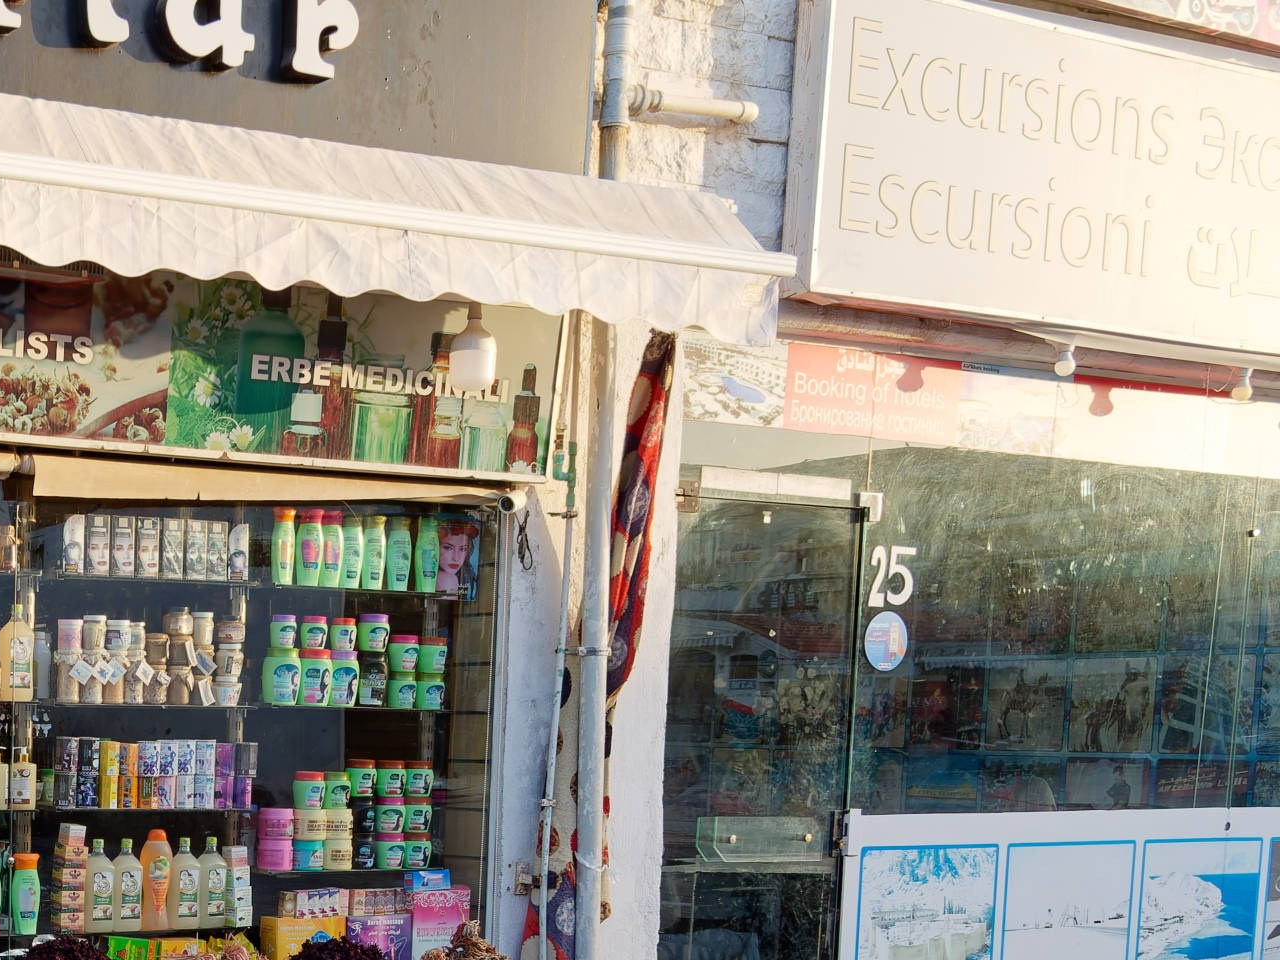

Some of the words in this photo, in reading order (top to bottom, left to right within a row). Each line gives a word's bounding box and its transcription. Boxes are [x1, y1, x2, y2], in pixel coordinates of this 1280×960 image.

[848, 16, 1176, 166] Excursions
[838, 143, 1153, 278] Escursioni
[250, 353, 332, 388] ERBE
[794, 371, 867, 406] Booking
[871, 382, 891, 402] of
[790, 399, 885, 432] Бронирование
[869, 545, 917, 607] 25
